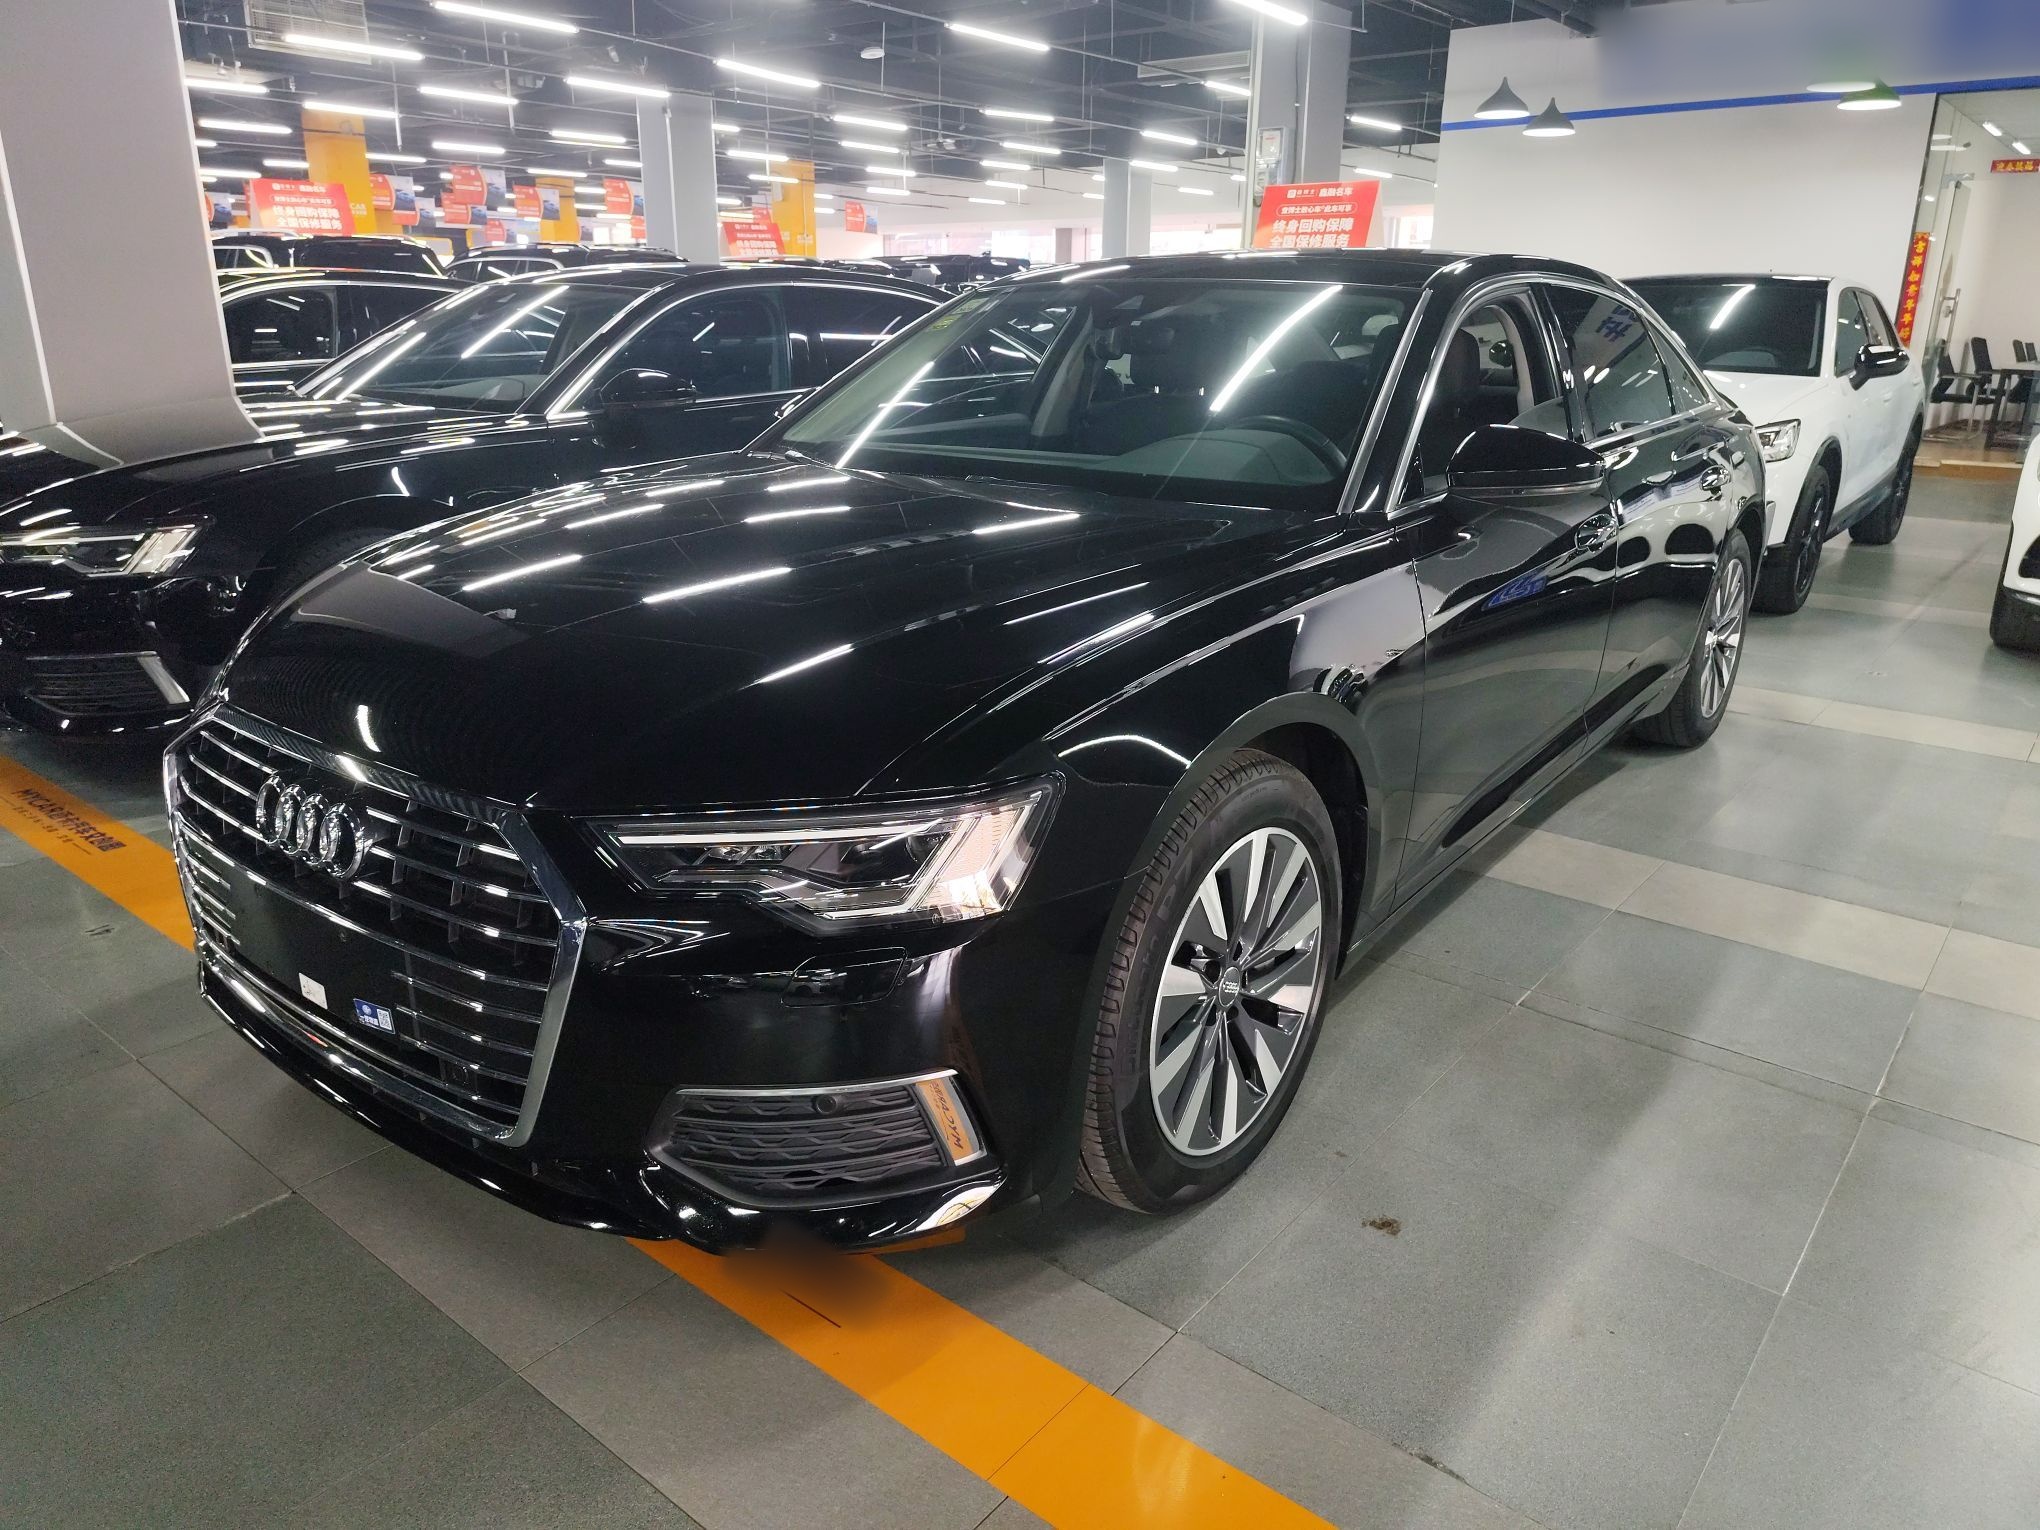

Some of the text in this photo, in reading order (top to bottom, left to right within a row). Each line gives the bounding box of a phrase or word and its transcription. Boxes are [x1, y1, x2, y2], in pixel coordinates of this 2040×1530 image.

[1272, 217, 1354, 233] 终身回购保障
